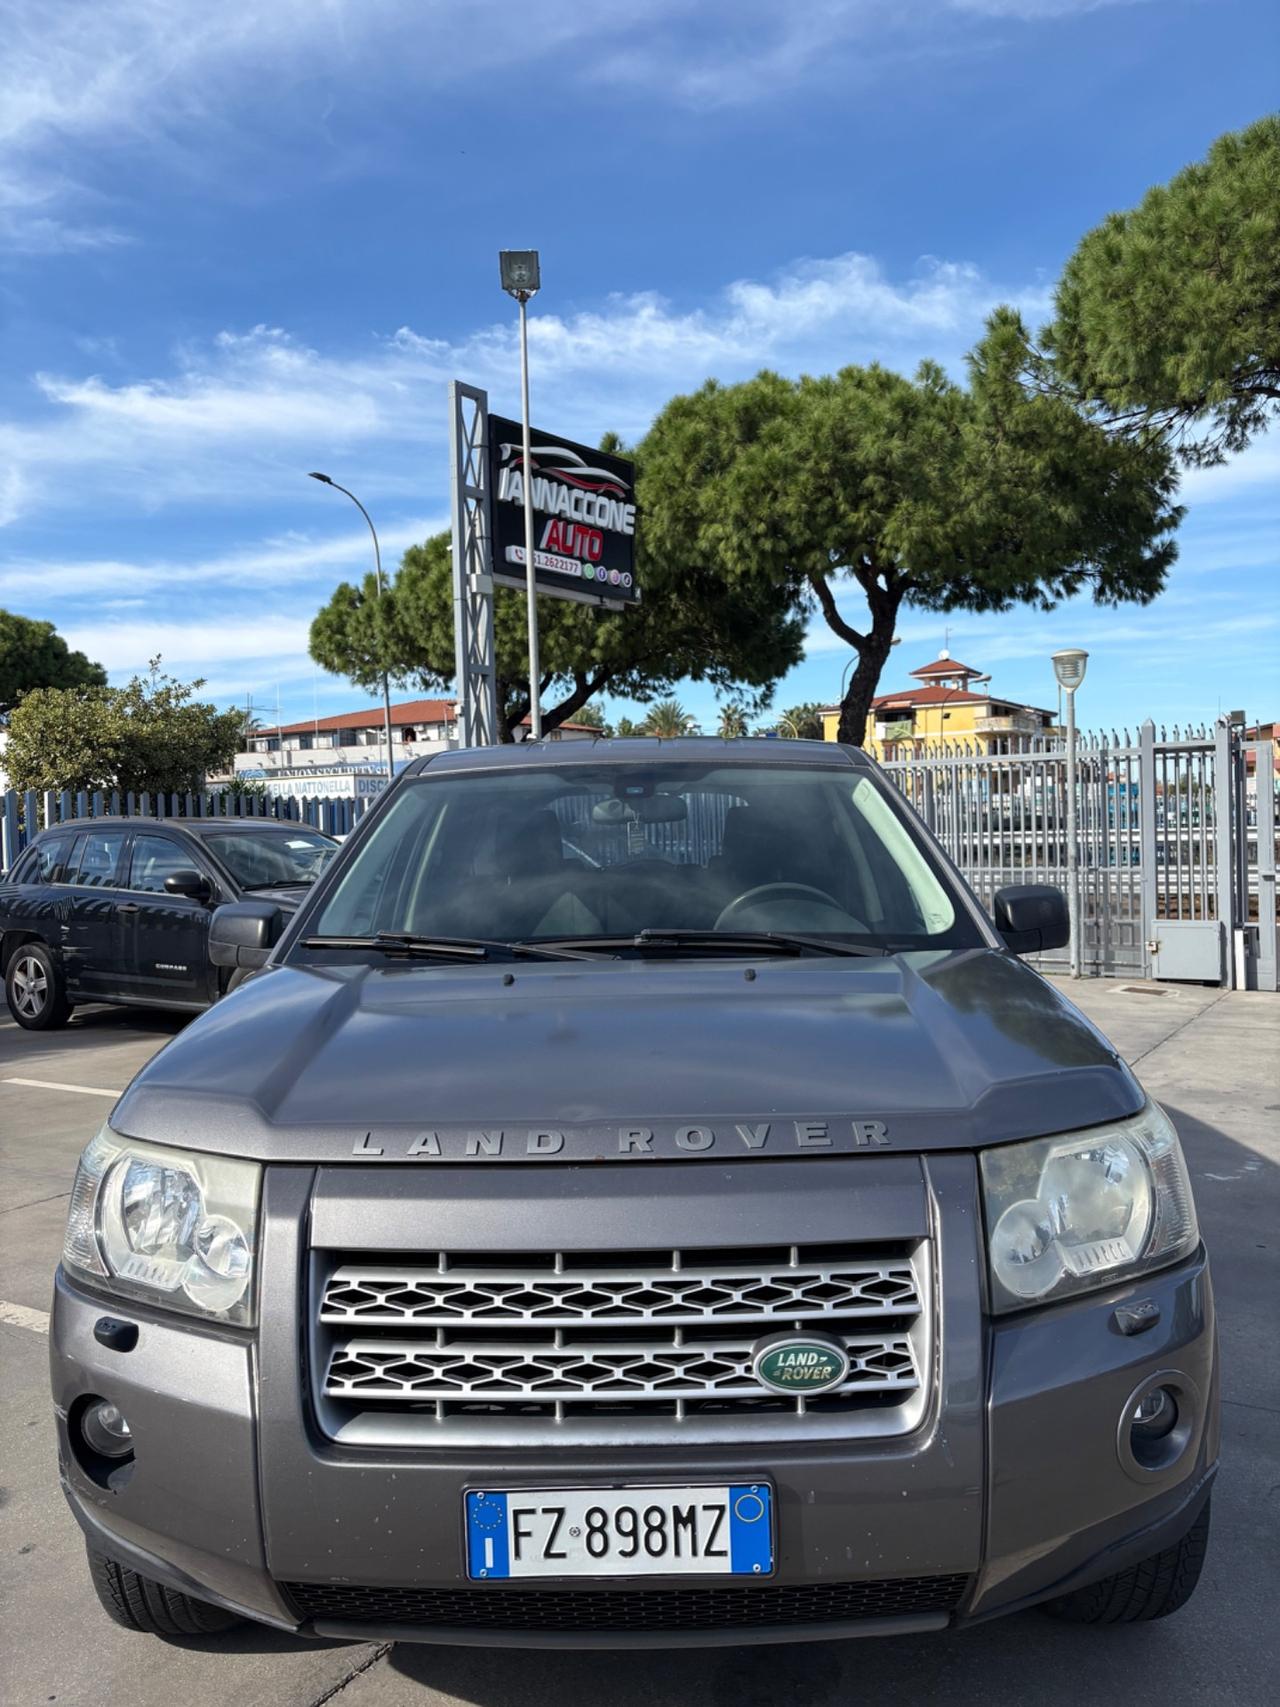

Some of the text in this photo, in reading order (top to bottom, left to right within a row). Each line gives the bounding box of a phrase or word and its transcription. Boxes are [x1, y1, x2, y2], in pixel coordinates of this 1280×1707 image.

[498, 467, 635, 534] IANNACCONE
[540, 519, 603, 561] AUTO
[294, 778, 351, 794] MATTONELLA
[358, 778, 386, 793] DISC
[352, 1120, 891, 1156] LAND ROVER
[782, 1366, 832, 1380] ROVER
